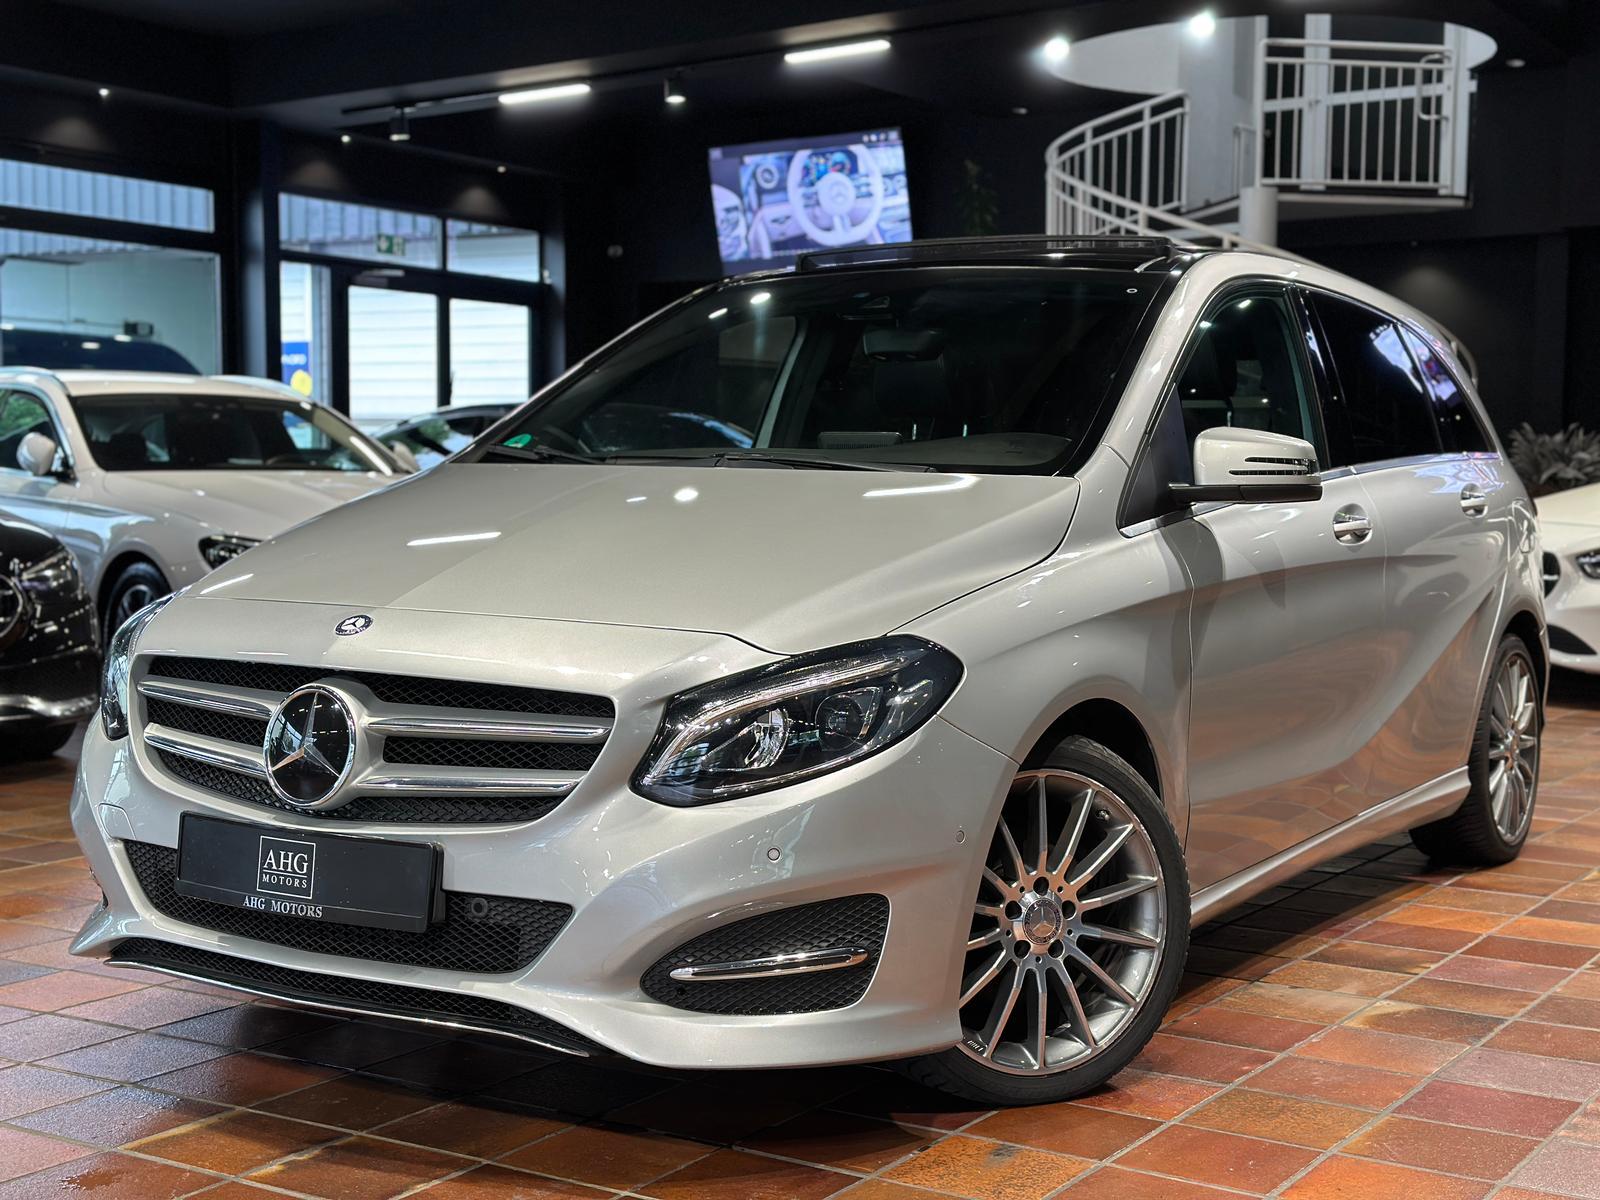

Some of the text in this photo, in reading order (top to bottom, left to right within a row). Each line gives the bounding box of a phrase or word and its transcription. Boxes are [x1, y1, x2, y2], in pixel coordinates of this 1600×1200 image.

[263, 849, 308, 874] AHG
[262, 873, 308, 888] MOTORS
[243, 895, 323, 918] AHG MOTORS
